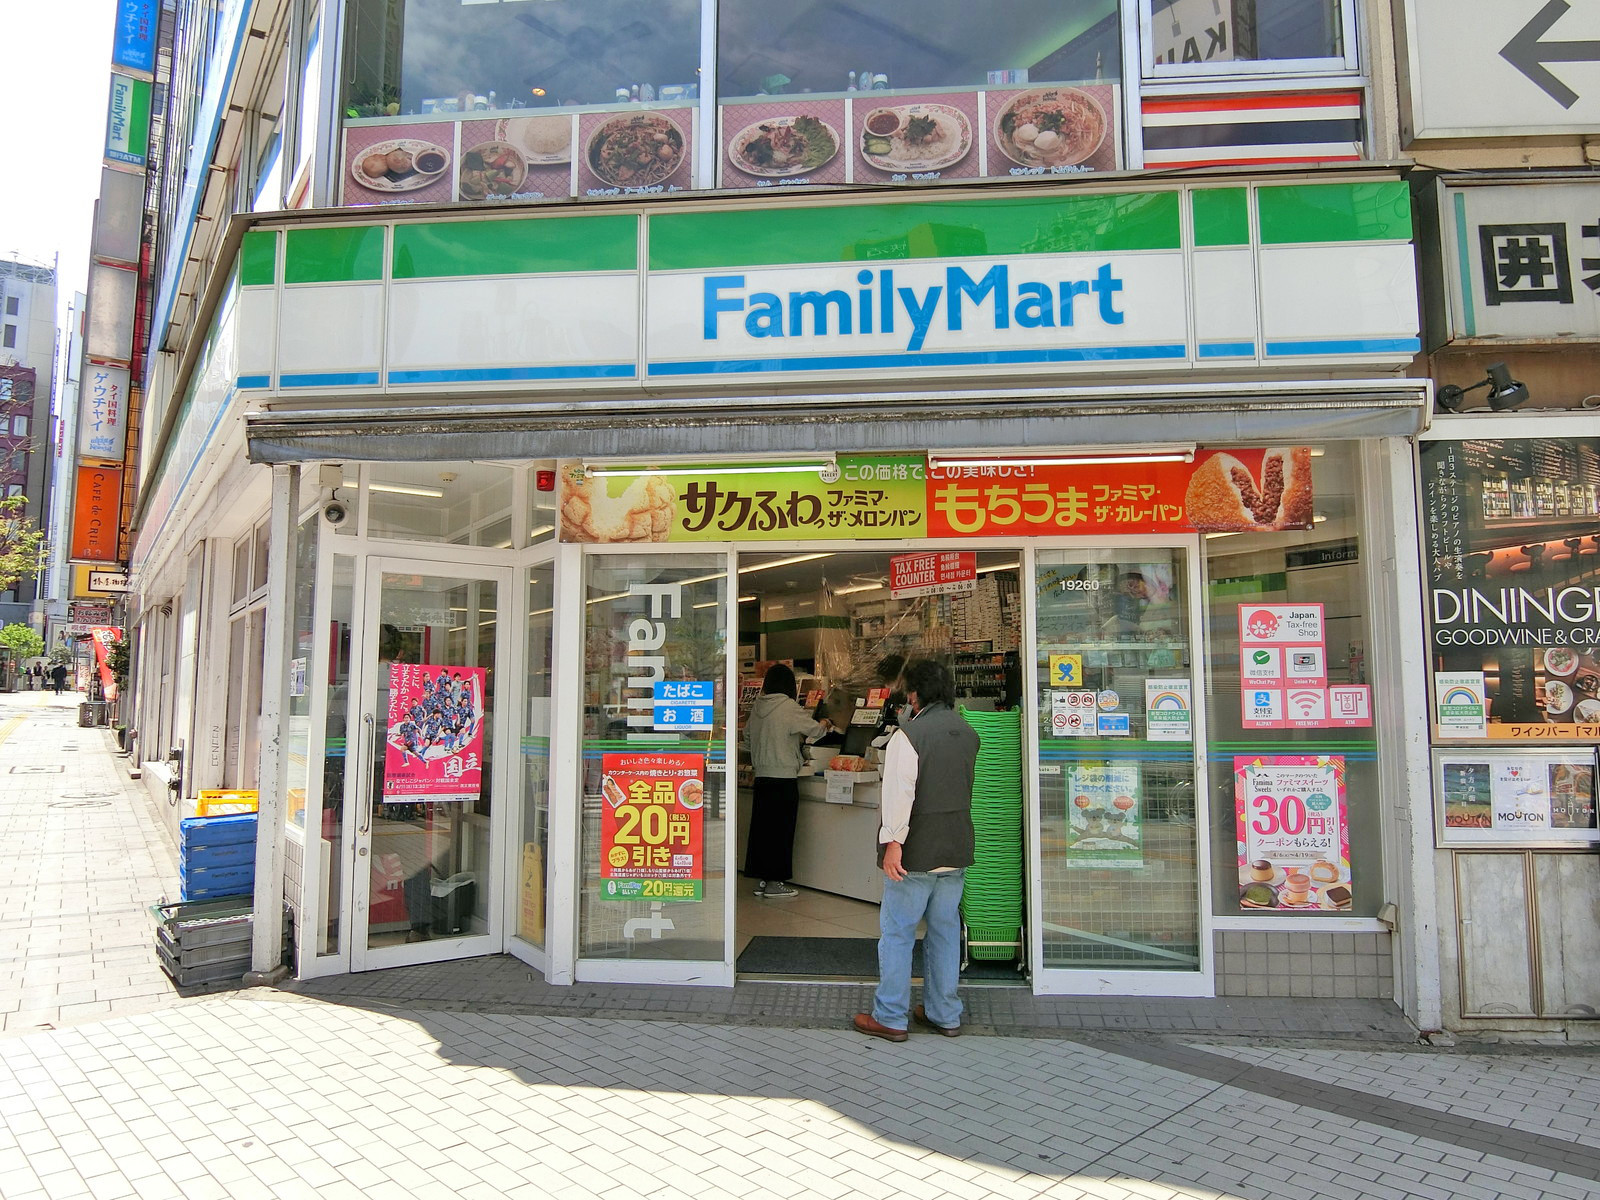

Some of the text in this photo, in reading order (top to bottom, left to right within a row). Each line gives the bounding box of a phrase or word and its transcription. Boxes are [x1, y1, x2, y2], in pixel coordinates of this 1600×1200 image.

[111, 82, 129, 141] FamilyMart
[703, 262, 1125, 352] FamilyMart
[90, 372, 109, 432] ゲウチャイ
[107, 384, 118, 426] タイ国料理
[934, 483, 1089, 533] もちうま
[1093, 503, 1183, 523] ザ・カレーパン
[827, 509, 922, 527] ザ・メロンパン
[895, 556, 936, 575] TAX FREE
[895, 569, 936, 586] COUNTER
[1059, 580, 1100, 591] 19260
[1286, 621, 1318, 629] Tax-free
[1289, 612, 1317, 620] Japan.
[1298, 629, 1318, 637] Shop
[1435, 628, 1551, 646] GOODWINE
[1554, 629, 1568, 645] &
[663, 684, 704, 698] たばこ
[1253, 707, 1272, 715] 支付宝
[628, 780, 676, 804] 全品
[669, 813, 690, 822] (税込)
[1257, 838, 1331, 848] クーポンもらえる!
[632, 846, 672, 867] 引き
